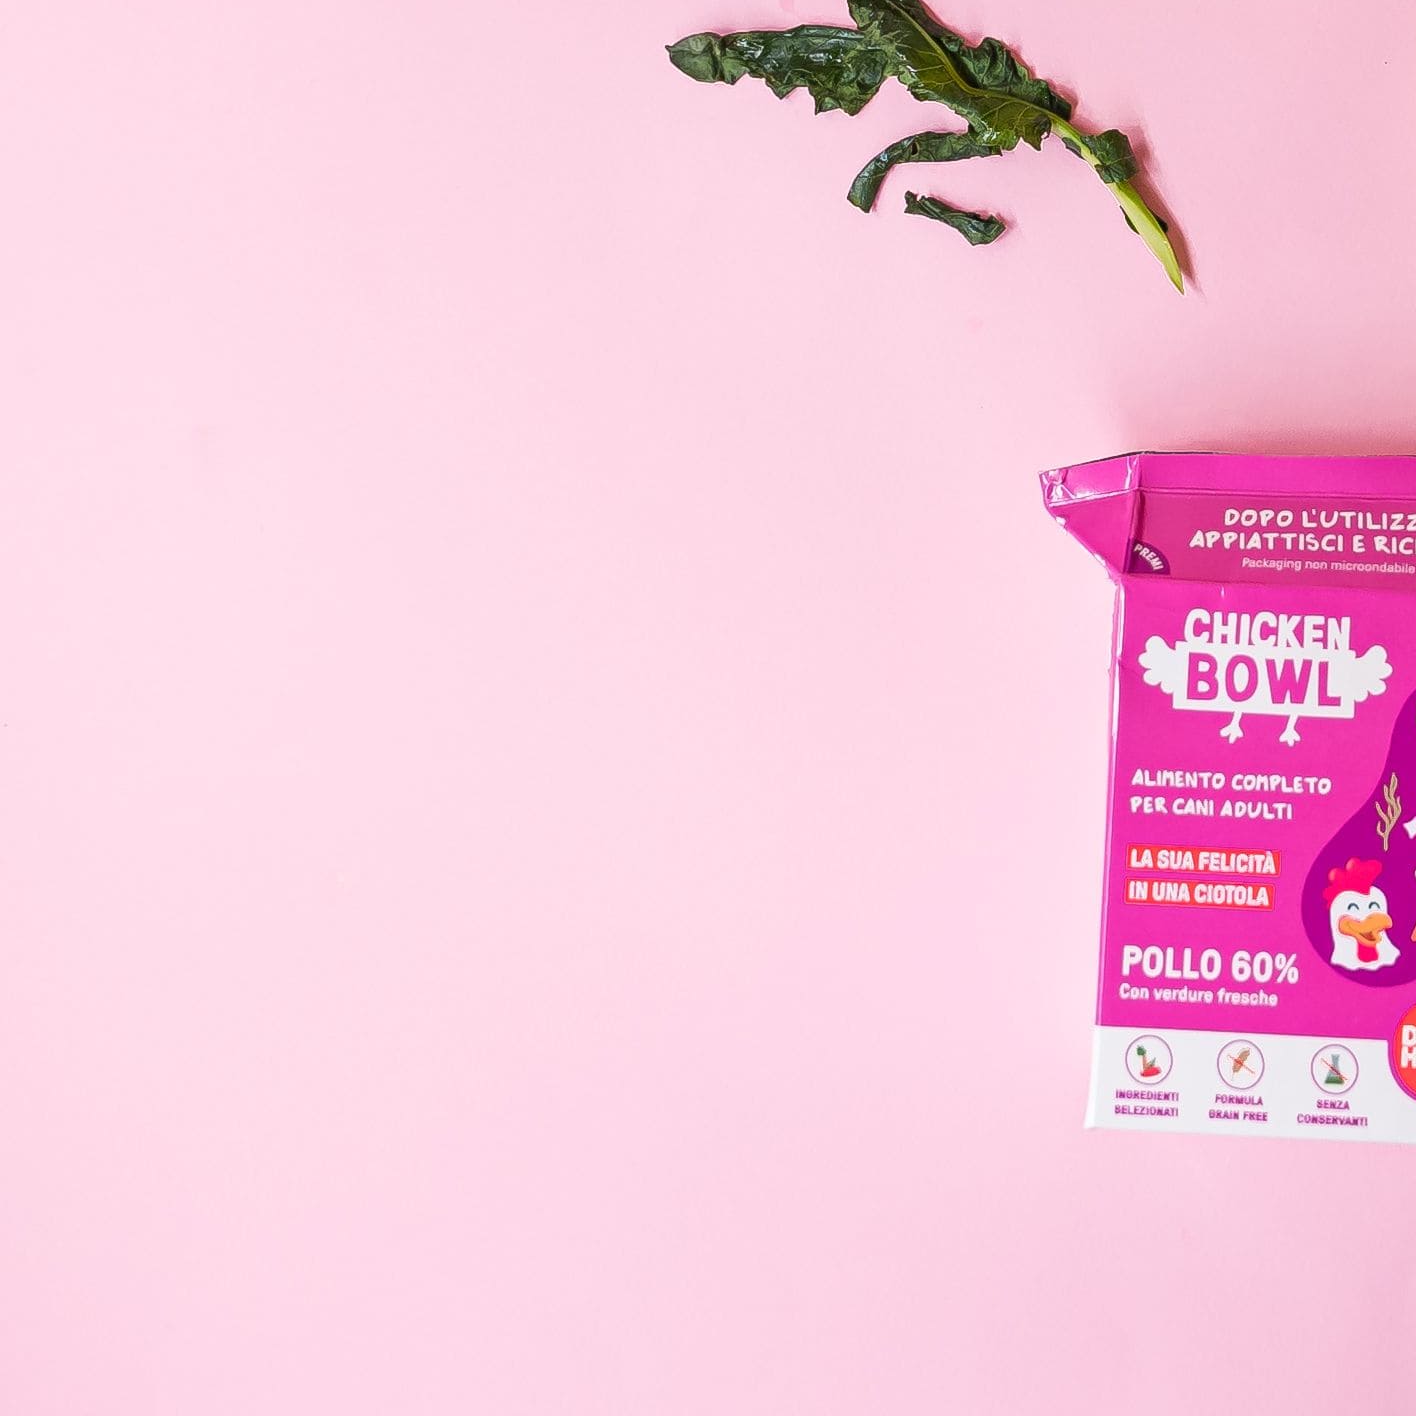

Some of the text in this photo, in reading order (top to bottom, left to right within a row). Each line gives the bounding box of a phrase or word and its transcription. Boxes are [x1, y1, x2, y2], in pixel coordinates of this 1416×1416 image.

[1224, 508, 1294, 527] DOPO
[1189, 530, 1344, 552] APPIATTISCI
[1352, 534, 1366, 554] E
[1133, 542, 1162, 572] PREMI
[1242, 556, 1416, 574] Packaging non microondabile
[1184, 608, 1352, 650] CHICKEN
[1186, 651, 1343, 707] BOWL
[1131, 768, 1332, 794] ALIMENTO COMPLETO
[1130, 796, 1293, 820] PER CANI ADULTI
[1130, 848, 1277, 874] LA SUA FELICITÀ
[1129, 880, 1269, 906] IN UNA CIOTOLA
[1121, 944, 1299, 984] POLLO 60%
[1119, 983, 1278, 1006] Con verdure fresche
[1115, 1089, 1179, 1102] INGREDIENTI
[1214, 1093, 1263, 1106] FORMULA
[1316, 1098, 1350, 1111] SENZA
[1114, 1104, 1179, 1117] SELEZIONATI
[1208, 1108, 1268, 1122] GRAIN FREE
[1296, 1113, 1368, 1127] CONSERVANTI
